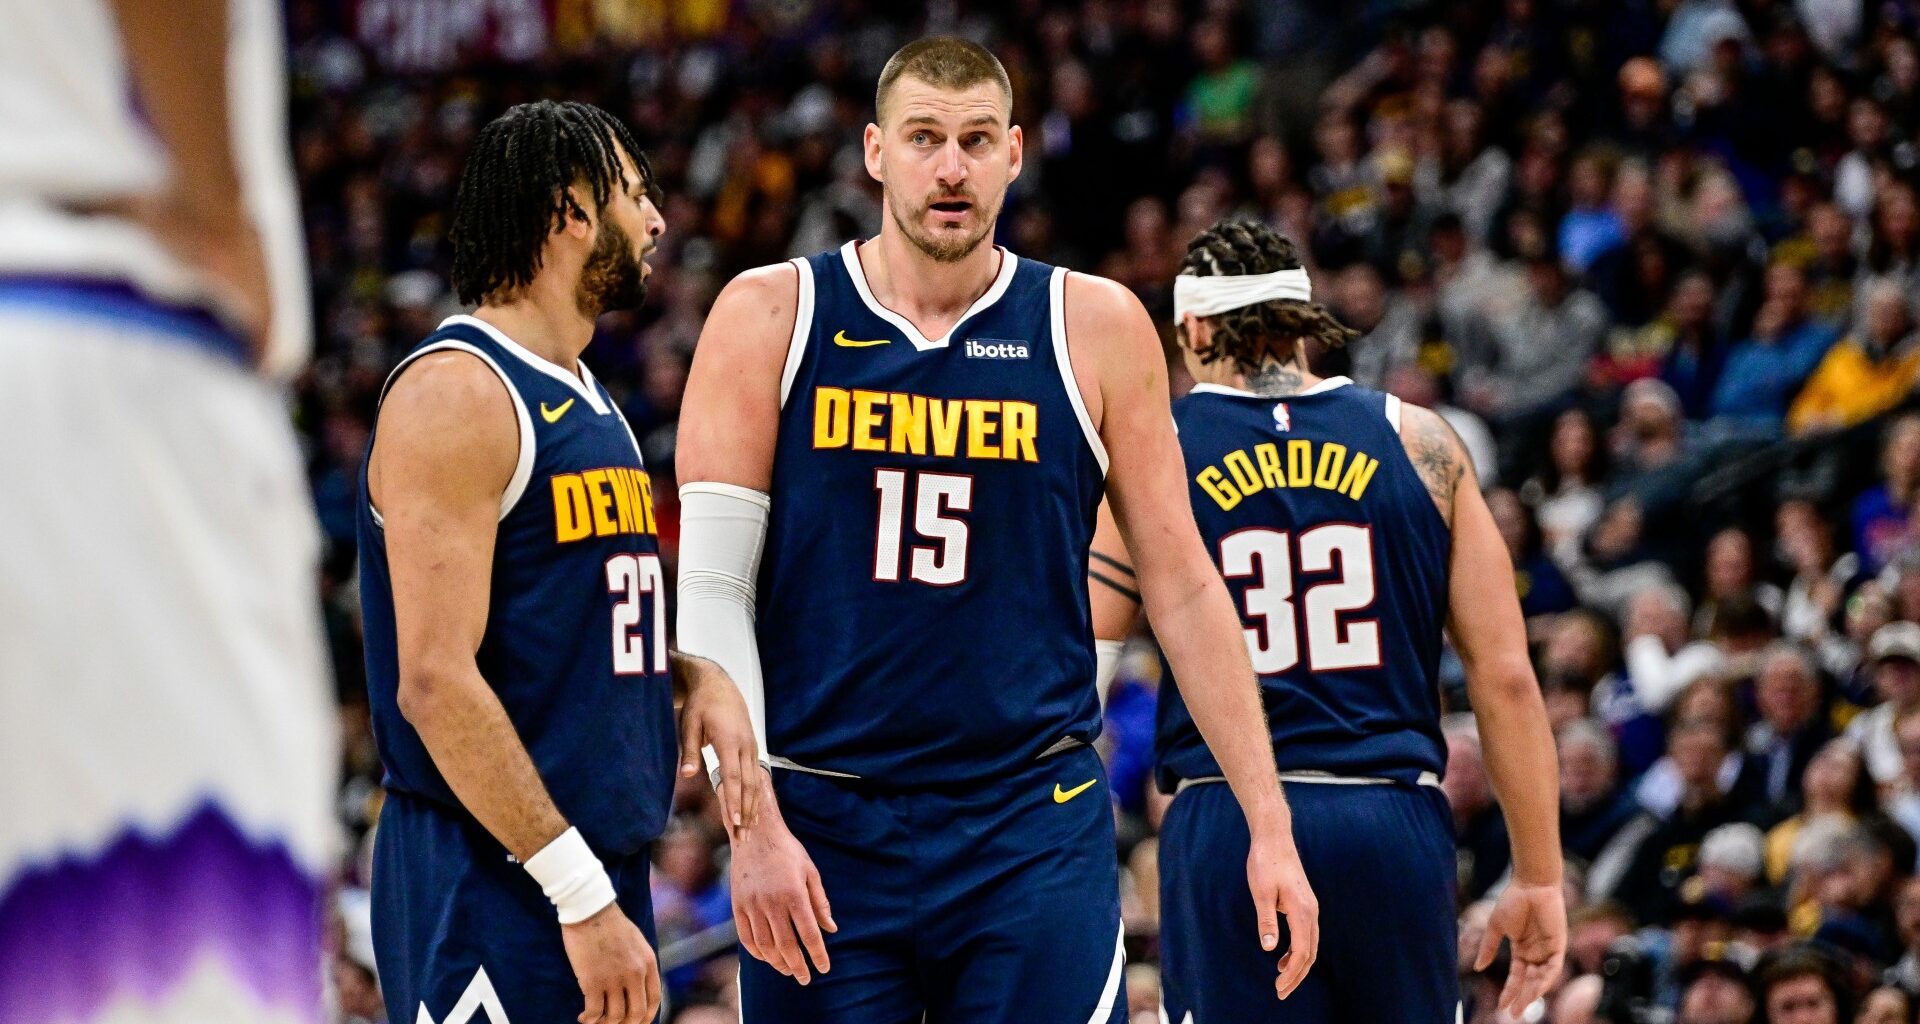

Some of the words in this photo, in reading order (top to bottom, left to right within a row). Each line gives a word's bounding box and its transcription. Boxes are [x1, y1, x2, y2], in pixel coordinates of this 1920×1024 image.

[966, 340, 1028, 358] ibotta
[813, 386, 1039, 462] DENVER
[551, 467, 657, 543] DENVE
[1196, 439, 1379, 511] GORDON
[873, 467, 973, 587] 15
[605, 553, 668, 675] 27
[1218, 520, 1383, 676] 32
